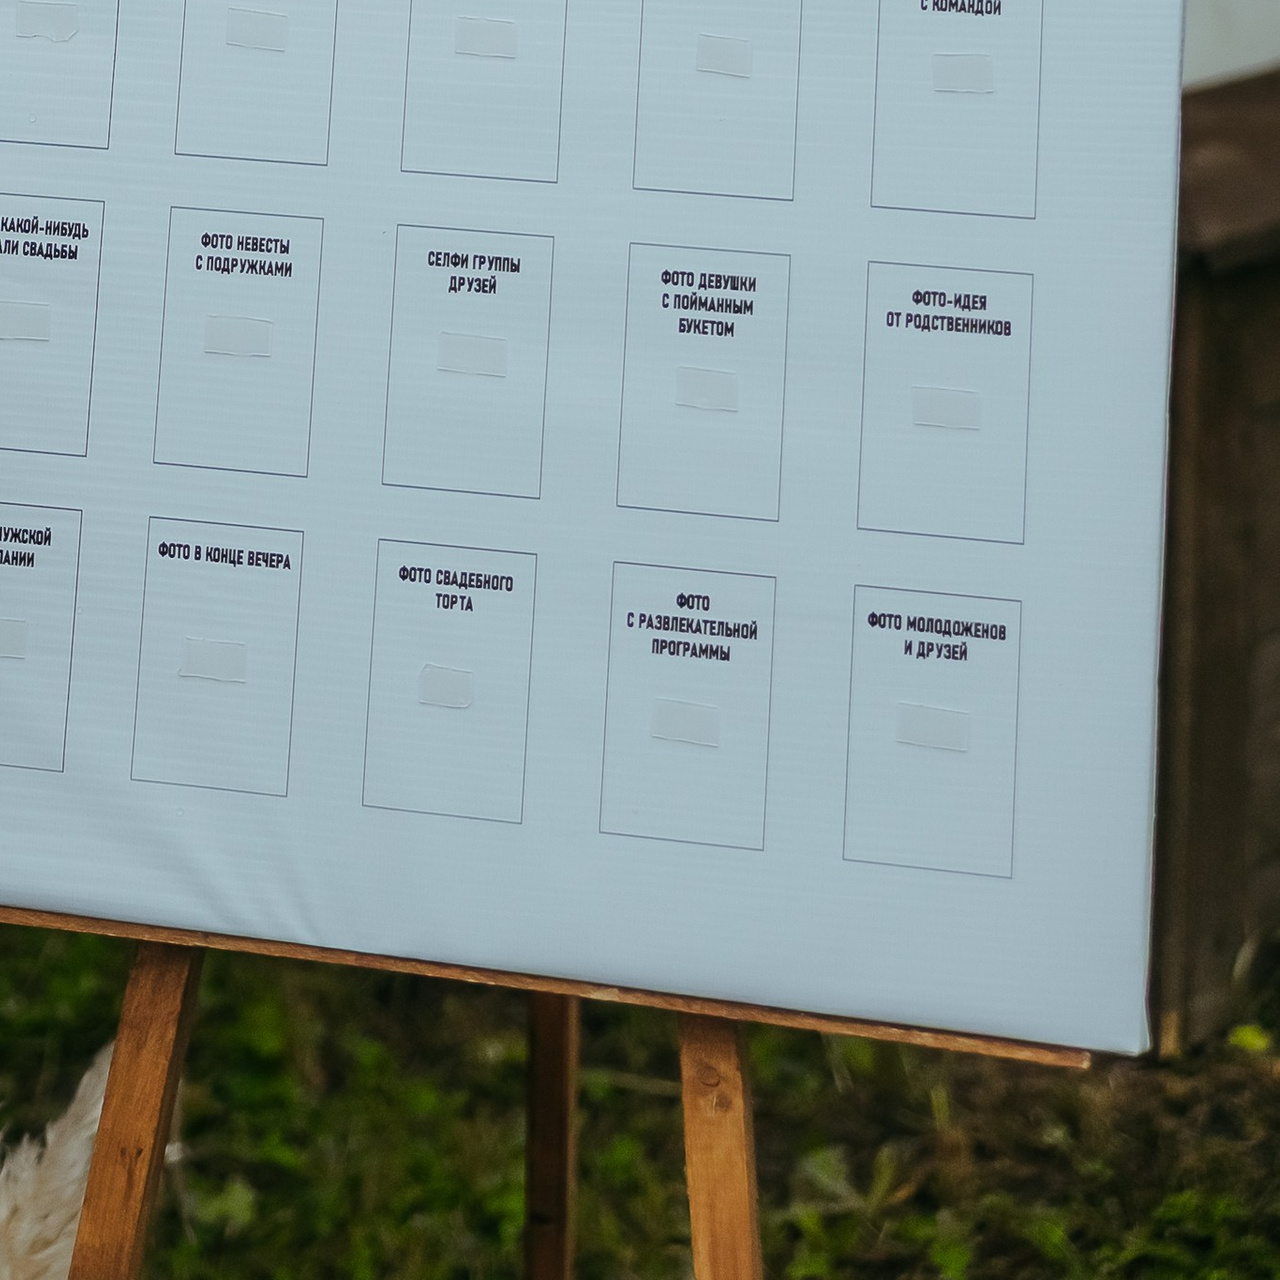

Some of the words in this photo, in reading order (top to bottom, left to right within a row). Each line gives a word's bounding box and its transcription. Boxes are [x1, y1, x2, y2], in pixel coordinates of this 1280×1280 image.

[0, 215, 90, 241] КАКОЙ-НИБУДЬ
[22, 240, 79, 261] СВАДЬБЫ
[200, 231, 234, 250] ФОТО
[236, 235, 290, 255] НЕВЕСТЫ
[195, 254, 204, 271] С
[206, 255, 293, 278] ПОДРУЖКАМИ
[427, 250, 469, 270] СЕЛФИ
[472, 254, 521, 274] ГРУППЫ
[447, 274, 497, 295] ДРУЗЕЙ
[660, 269, 695, 288] ФОТО
[697, 272, 757, 293] ДЕВУШКИ
[661, 292, 670, 309] С
[673, 291, 754, 316] ПОЙМАННЫМ
[911, 289, 987, 313] ФОТО-ИДЕЯ
[678, 317, 735, 338] БУКЕТОМ
[886, 310, 902, 328] ОТ
[905, 312, 1012, 337] РОДСТВЕННИКОВ
[158, 541, 191, 560] ФОТО
[193, 544, 202, 561] В
[205, 545, 245, 568] КОНЦЕ
[247, 550, 291, 571] ВЕЧЕРА
[398, 564, 432, 584] ФОТО
[435, 569, 514, 592] СВАДЕБНОГО
[435, 592, 474, 612] ТОРТА
[675, 592, 711, 612] ФОТО
[626, 611, 635, 628] С
[638, 612, 758, 641] РАЗВЛЕКАТЕЛЬНОЙ
[867, 611, 903, 631] ФОТО
[906, 615, 1007, 641] МОЛОДОЖЕНОВ
[651, 638, 731, 662] ПРОГРАММЫ
[903, 639, 913, 656] И
[915, 640, 968, 661] ДРУЗЕЙ
